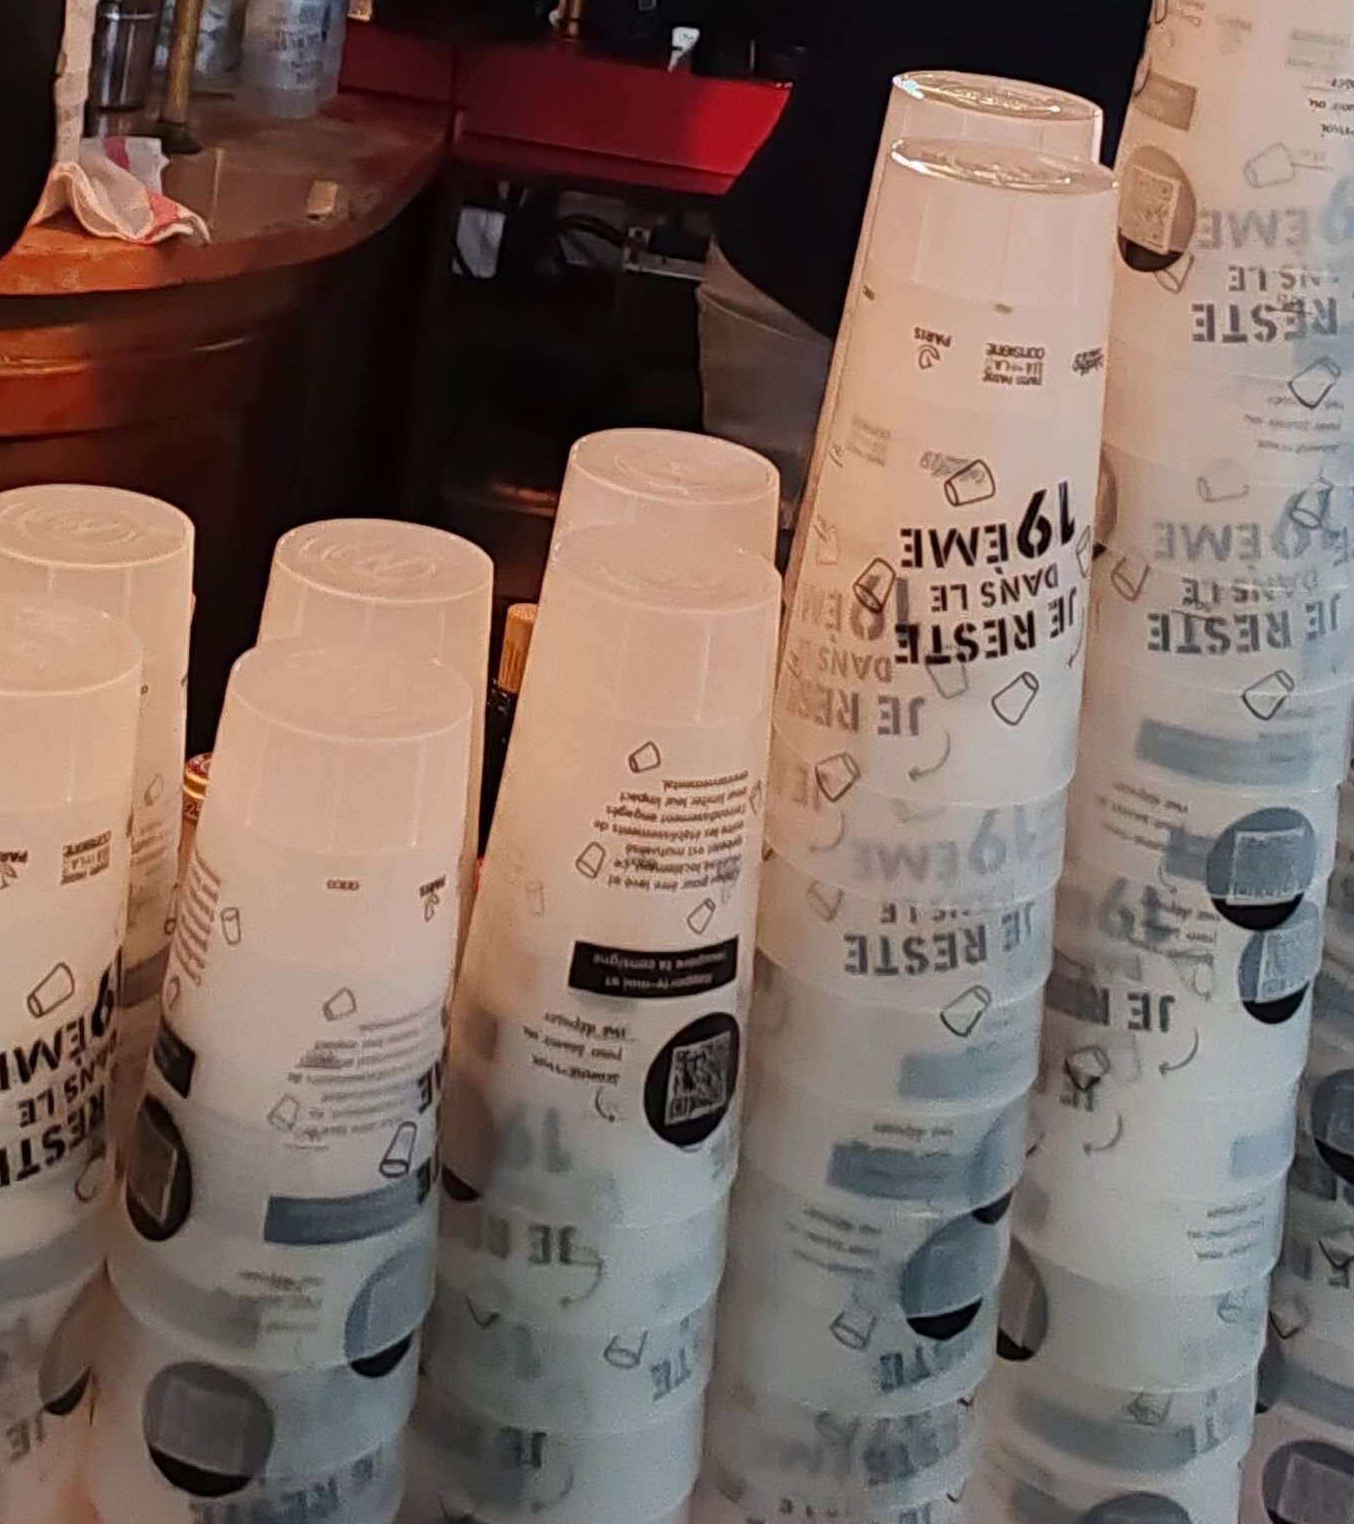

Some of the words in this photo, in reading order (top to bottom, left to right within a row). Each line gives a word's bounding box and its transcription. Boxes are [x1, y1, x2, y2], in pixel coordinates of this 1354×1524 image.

[1228, 265, 1266, 292] LE
[914, 327, 951, 347] PARIS
[1191, 296, 1337, 344] RESTE
[900, 481, 1075, 576] 19ÈME
[930, 584, 968, 613] LE
[980, 563, 1059, 608] DANS
[1049, 587, 1077, 639] JE
[1147, 610, 1291, 655] RESTE
[1305, 594, 1341, 640] JE
[894, 610, 1036, 665] RESTE
[877, 696, 925, 737] JE
[619, 792, 661, 808] impact
[593, 821, 609, 832] de
[1001, 901, 1036, 952] JE
[592, 953, 655, 970] consigne
[843, 925, 987, 975] RESTE
[1127, 993, 1176, 1034] JE
[17, 1087, 54, 1128] LE
